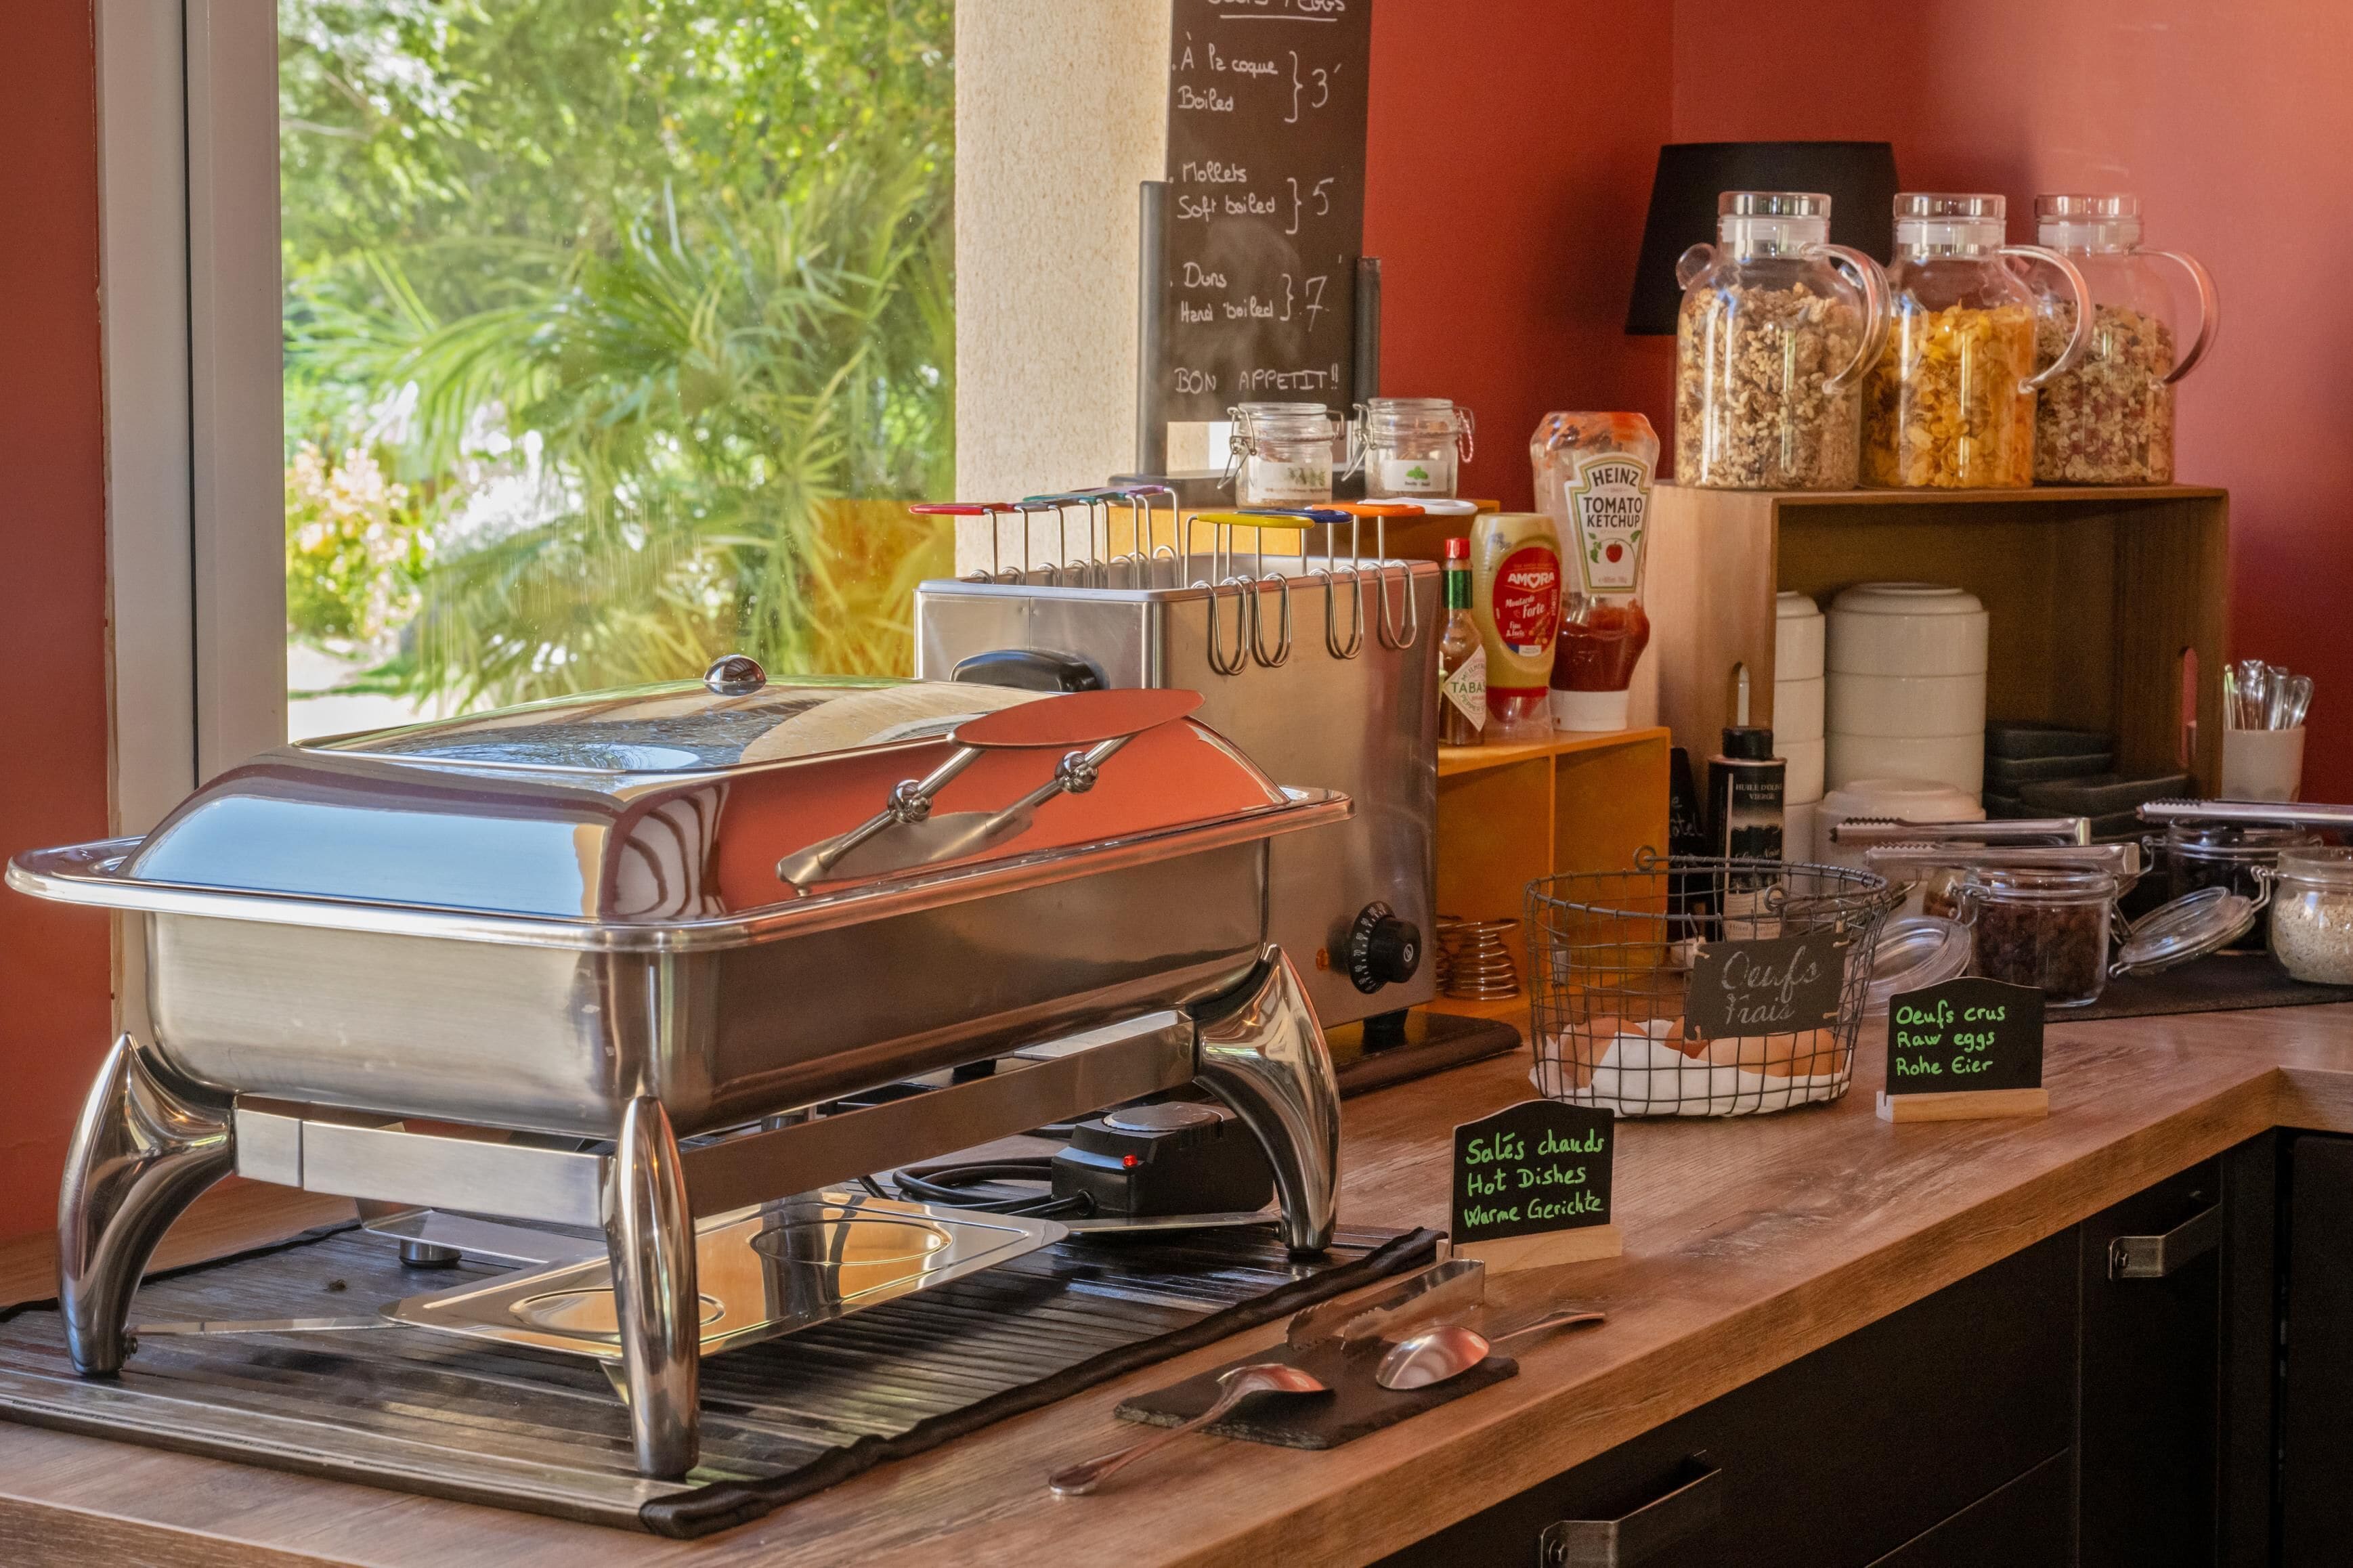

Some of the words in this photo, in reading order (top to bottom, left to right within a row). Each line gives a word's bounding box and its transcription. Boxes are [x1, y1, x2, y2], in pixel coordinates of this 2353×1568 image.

[1231, 60, 1278, 79] coque
[1177, 85, 1234, 111] Boiled
[1182, 160, 1247, 183] Mollets
[1177, 195, 1217, 223] Soft
[1224, 192, 1276, 215] boiled
[1224, 295, 1274, 319] boiled
[1174, 368, 1217, 395] BON
[1591, 467, 1639, 487] HEINZ
[1583, 496, 1643, 515] TOMATO
[1586, 515, 1641, 528] KETCHUP
[1507, 571, 1555, 589] AMORA
[1522, 603, 1546, 619] Forte
[1896, 999, 1955, 1029] Oeufs
[1964, 1005, 2006, 1022] crus
[1897, 1031, 1942, 1048] Raw
[1953, 1031, 1995, 1053] eggs
[1895, 1055, 1943, 1076] Rohe
[1951, 1056, 1993, 1074] Eier
[1466, 1132, 1524, 1164] Salés
[1537, 1128, 1605, 1155] chauds
[1467, 1168, 1507, 1197] Hot
[1516, 1163, 1586, 1188] Dishes
[1464, 1204, 1521, 1228] Warme
[1527, 1190, 1604, 1219] Gerichte
